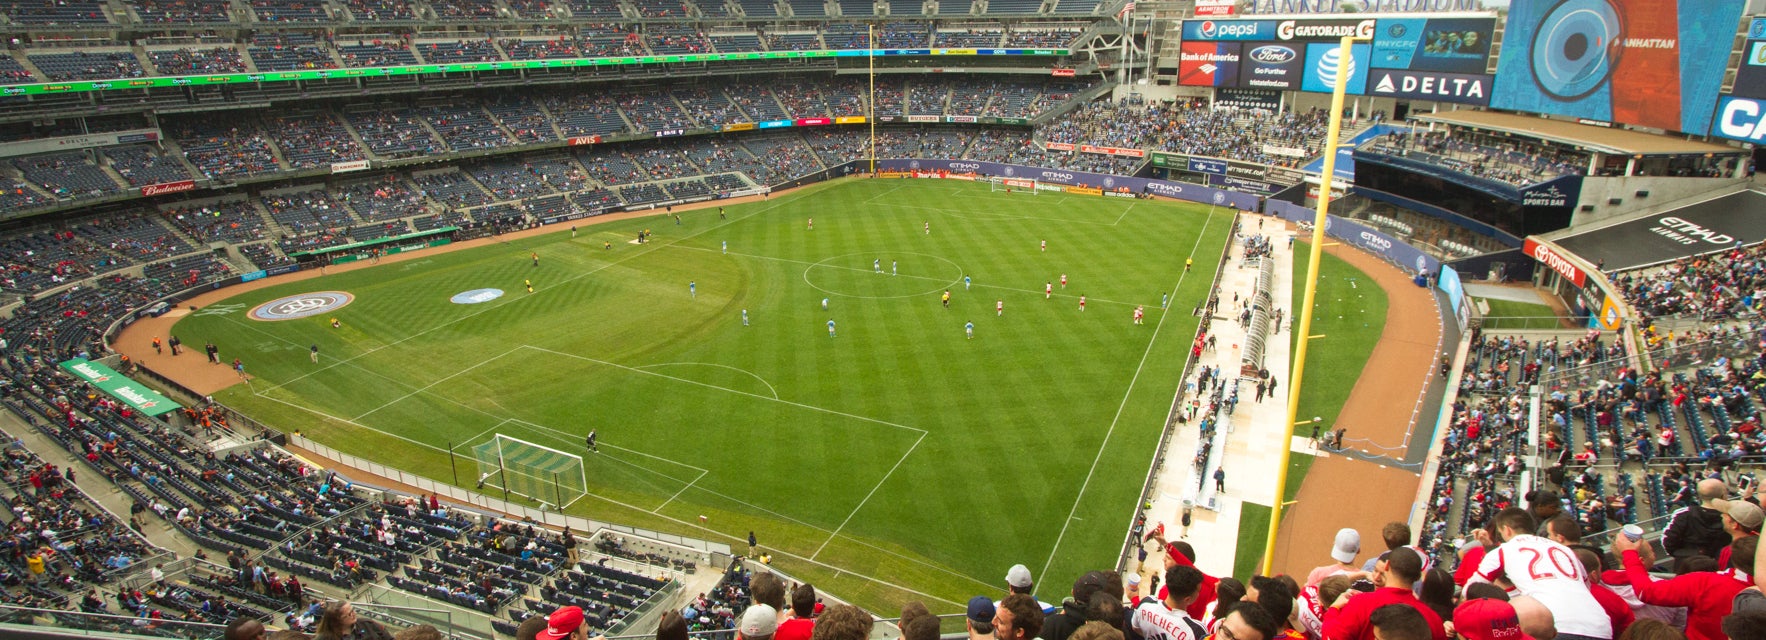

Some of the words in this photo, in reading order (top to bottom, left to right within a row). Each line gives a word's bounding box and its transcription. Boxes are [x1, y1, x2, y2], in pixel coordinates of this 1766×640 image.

[1218, 22, 1257, 38] pepsi
[1295, 25, 1356, 36] GATORADE
[1375, 40, 1417, 48] #NYCFC
[1180, 52, 1198, 61] Bank
[1199, 53, 1208, 61] of
[1208, 53, 1239, 63] America
[1257, 48, 1288, 62] Ford
[1249, 79, 1289, 87] tristateford.com
[1401, 75, 1483, 98] DELTA
[575, 136, 595, 145] AVIS
[1042, 171, 1073, 180] ETIHAD
[143, 183, 194, 196] Budweiser
[1147, 182, 1182, 193] ETIHAD
[1523, 198, 1550, 206] SPORTS
[1648, 226, 1699, 245] AIRWAYS
[1659, 216, 1734, 244] ETIHAD
[1360, 231, 1392, 249] ETIHAD
[1547, 251, 1576, 281] TOYOTA
[1583, 286, 1602, 312] COACH
[113, 386, 149, 405] Heineken
[1518, 546, 1580, 581] 20
[1141, 609, 1187, 640] PACHECO
